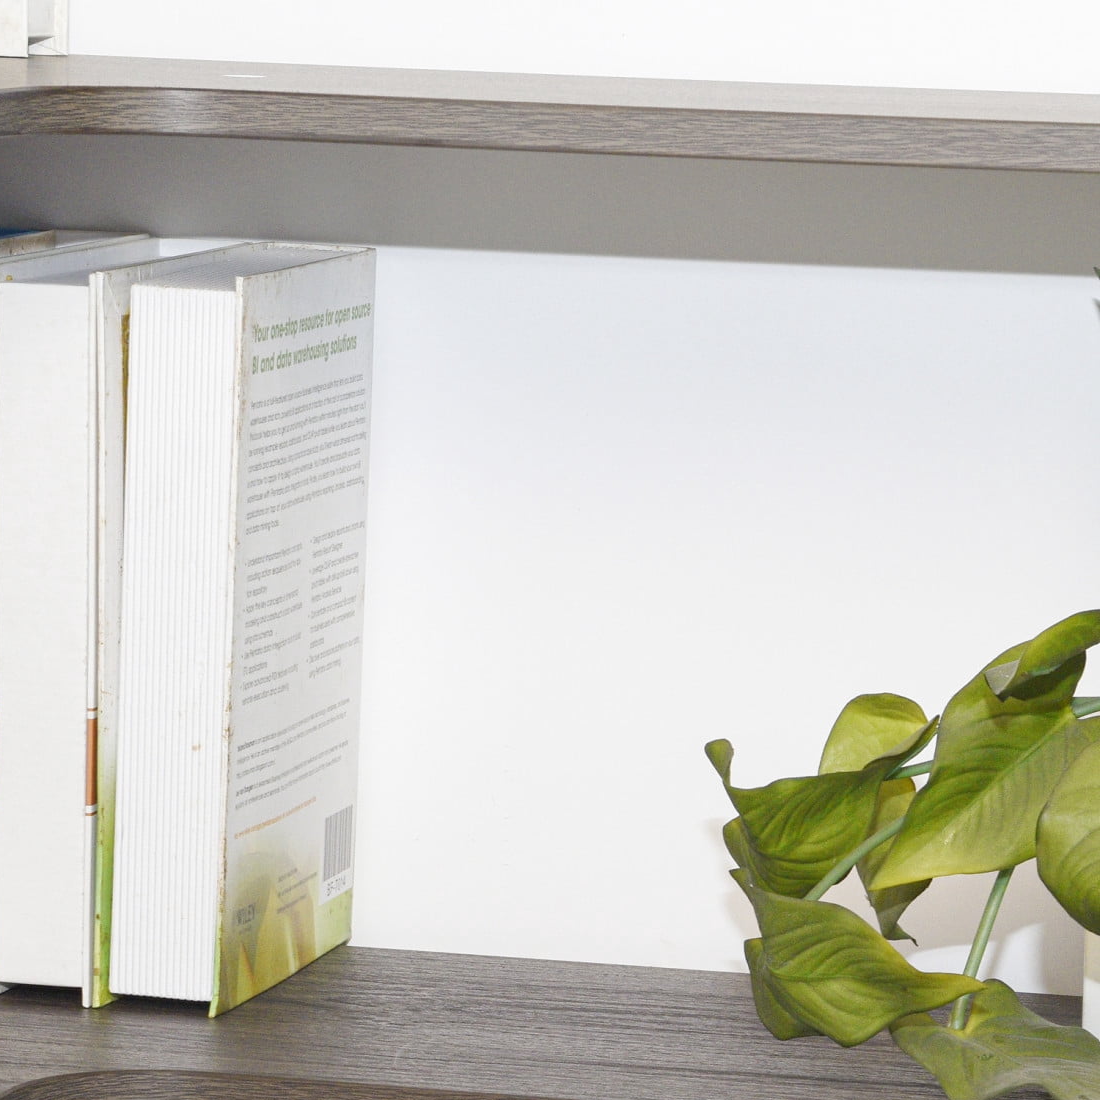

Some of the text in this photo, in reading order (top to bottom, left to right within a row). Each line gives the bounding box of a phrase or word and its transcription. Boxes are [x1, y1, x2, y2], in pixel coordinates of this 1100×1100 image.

[253, 303, 371, 342] Your one-stop resource for open source
[260, 352, 275, 373] and
[276, 348, 292, 369] data
[293, 340, 329, 362] warehousing
[330, 334, 357, 355] solutions
